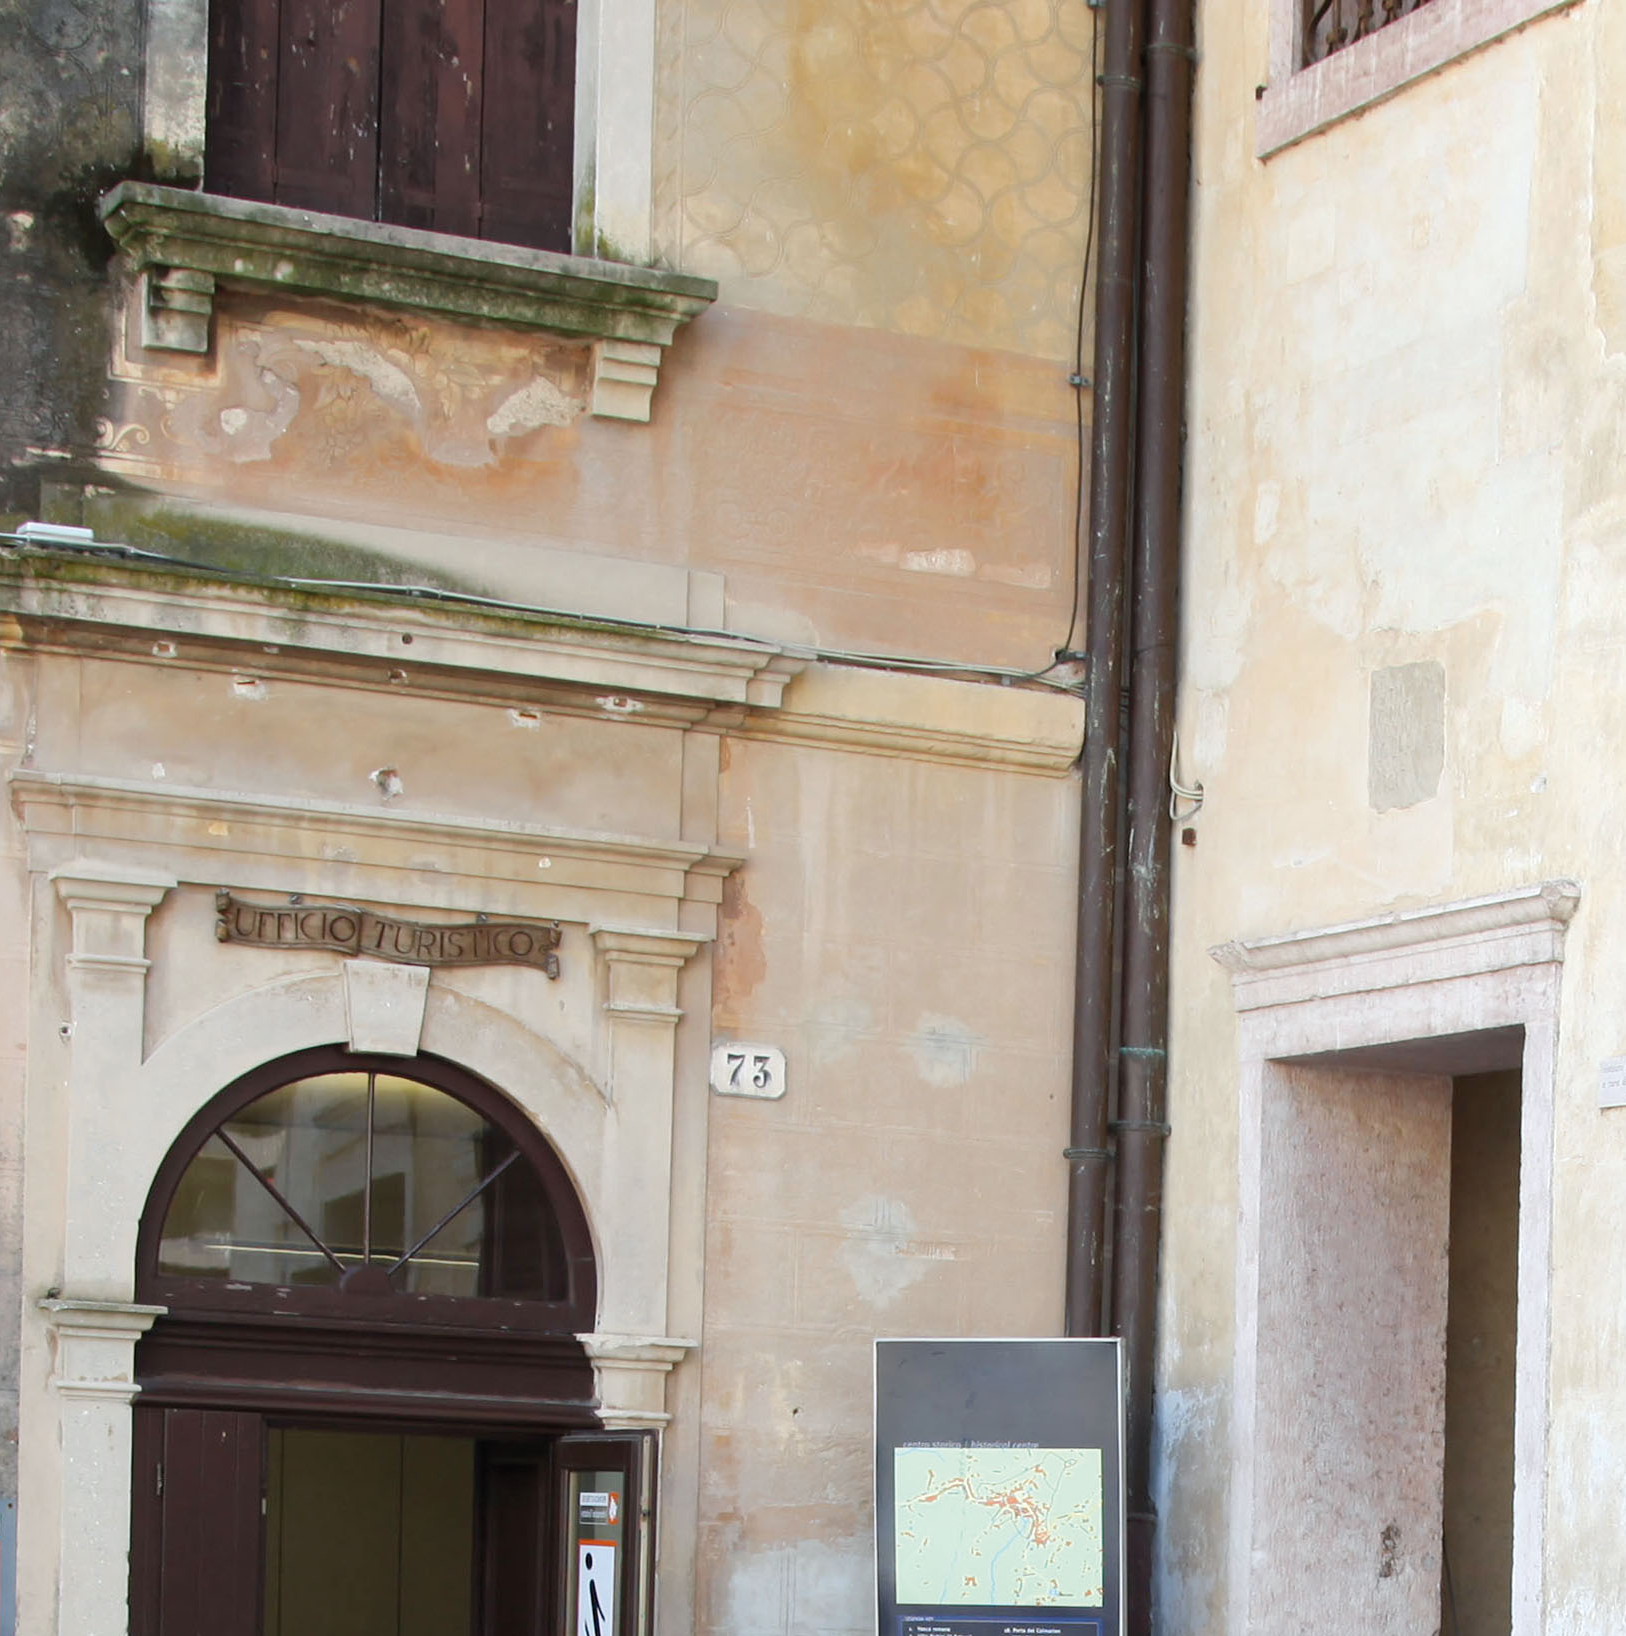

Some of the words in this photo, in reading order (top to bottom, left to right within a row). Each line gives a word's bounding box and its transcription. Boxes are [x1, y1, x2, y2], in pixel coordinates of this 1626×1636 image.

[236, 908, 357, 942] UFFICIO
[374, 920, 535, 958] TURISTICO
[726, 1053, 772, 1088] 73
